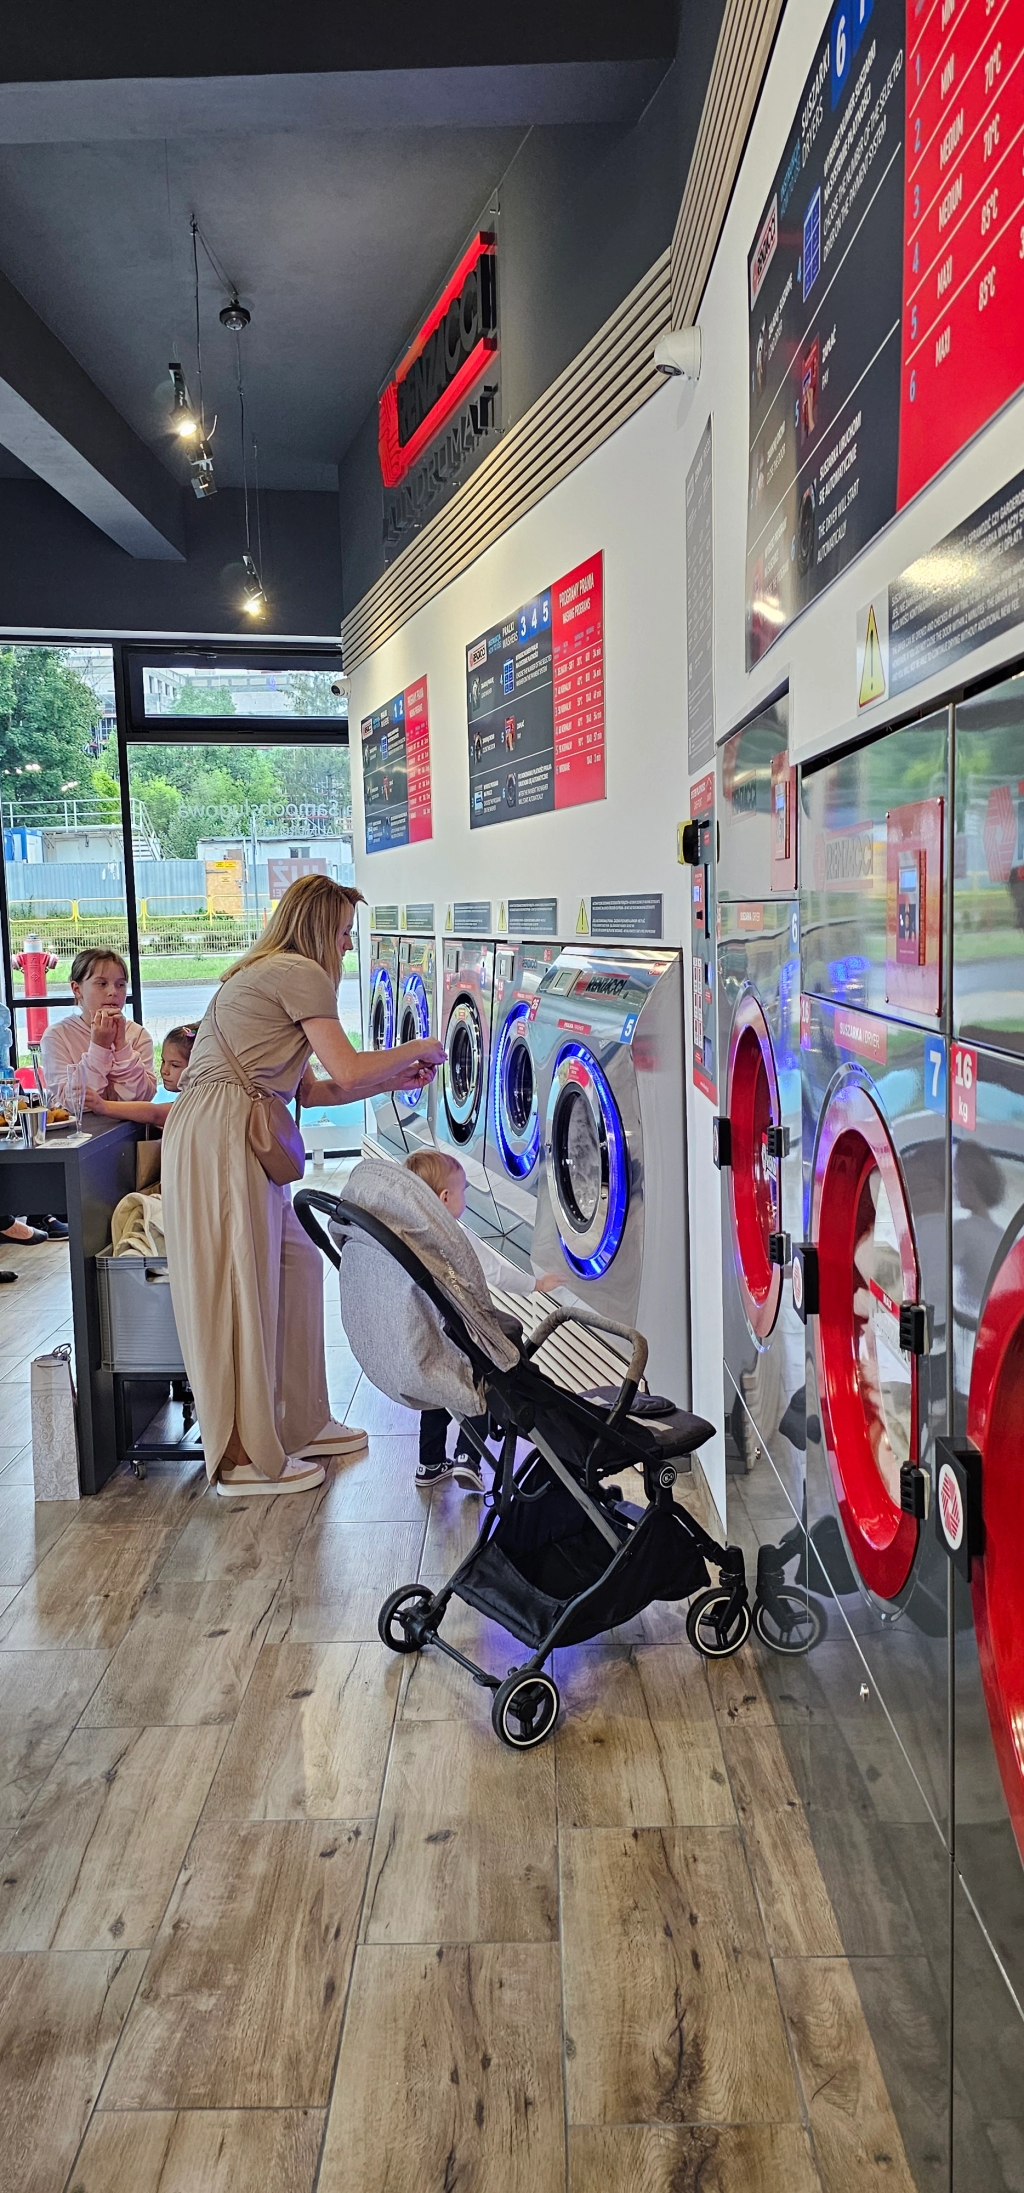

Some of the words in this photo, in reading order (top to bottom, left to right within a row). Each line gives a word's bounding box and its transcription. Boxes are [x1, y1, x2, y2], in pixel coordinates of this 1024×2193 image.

[836, 15, 846, 77] 6
[916, 54, 920, 85] 1
[802, 43, 829, 137] SUSZARKI
[914, 118, 920, 153] 2
[941, 54, 954, 99] MINI
[802, 96, 823, 168] DRYERS
[846, 136, 863, 186] NUMBER
[879, 49, 902, 113] SELECTED
[913, 184, 920, 219] 3
[940, 108, 963, 170] MEDIUM
[985, 42, 1001, 93] 70°C
[912, 242, 919, 273] 4
[939, 174, 962, 232] MEDIUM
[984, 113, 999, 162] 70°C
[911, 305, 917, 339] 5
[937, 255, 952, 298] MAXI
[981, 188, 998, 235] 85°C
[910, 370, 915, 402] 6
[936, 326, 950, 366] MAXI
[979, 266, 995, 311] 85°C
[795, 400, 799, 427] 5
[820, 445, 839, 481] SUSZARKA
[839, 411, 861, 454] URUCHOMI
[825, 443, 857, 498] AUTOMATYCZNIE
[826, 506, 837, 532] DRYER
[838, 495, 846, 517] WILL
[846, 478, 859, 508] START
[817, 519, 847, 564] AUTOMATICALLY
[502, 621, 514, 637] PRALKI
[521, 616, 526, 636] 3
[532, 608, 537, 628] 4
[543, 600, 548, 622] 5
[826, 833, 874, 881] RENZACCI
[792, 912, 798, 943] 6
[480, 971, 485, 985] 3
[585, 976, 627, 996] RENZACCI
[624, 1018, 634, 1037] 5
[839, 1022, 863, 1042] SUSZARKA
[864, 1033, 880, 1049] DRYER
[929, 1050, 942, 1098] 7
[955, 1051, 972, 1089] 16
[958, 1096, 968, 1123] kg
